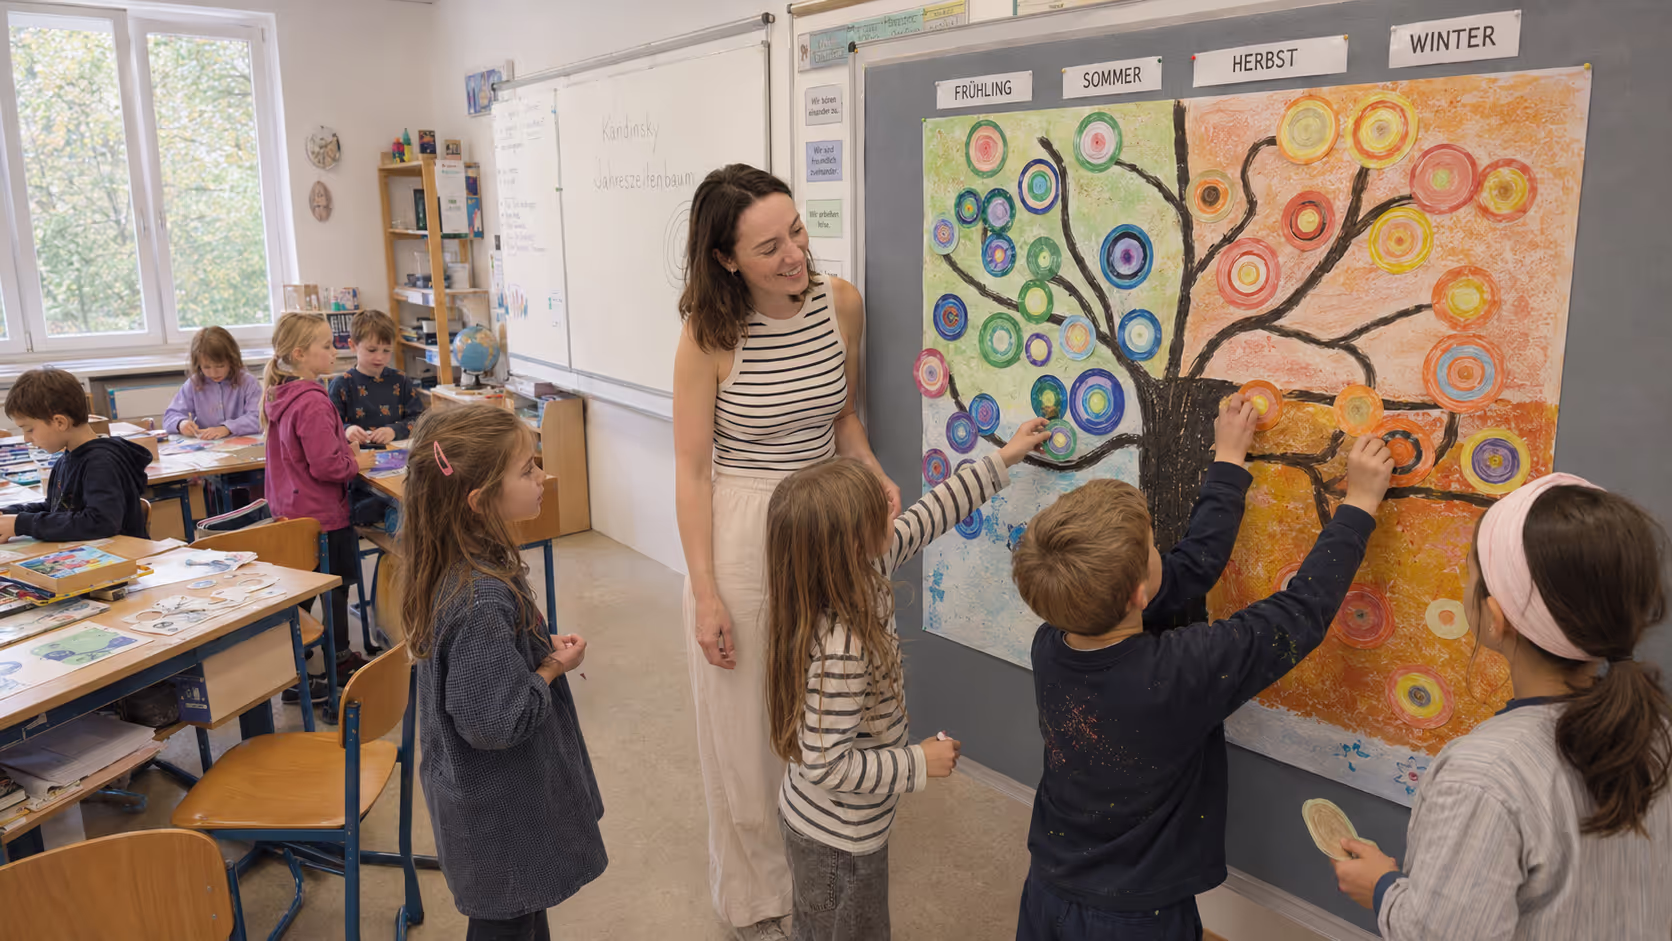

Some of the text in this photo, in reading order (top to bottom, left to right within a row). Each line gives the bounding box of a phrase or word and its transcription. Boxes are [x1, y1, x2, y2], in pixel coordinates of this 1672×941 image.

[1410, 25, 1496, 54] WINTER
[1232, 48, 1298, 73] HERBST
[954, 80, 1012, 101] FRÜHLING
[1083, 66, 1142, 89] SOMMER
[602, 112, 660, 154] Kandinsky
[593, 157, 696, 190] Jahreszeitenbaum
